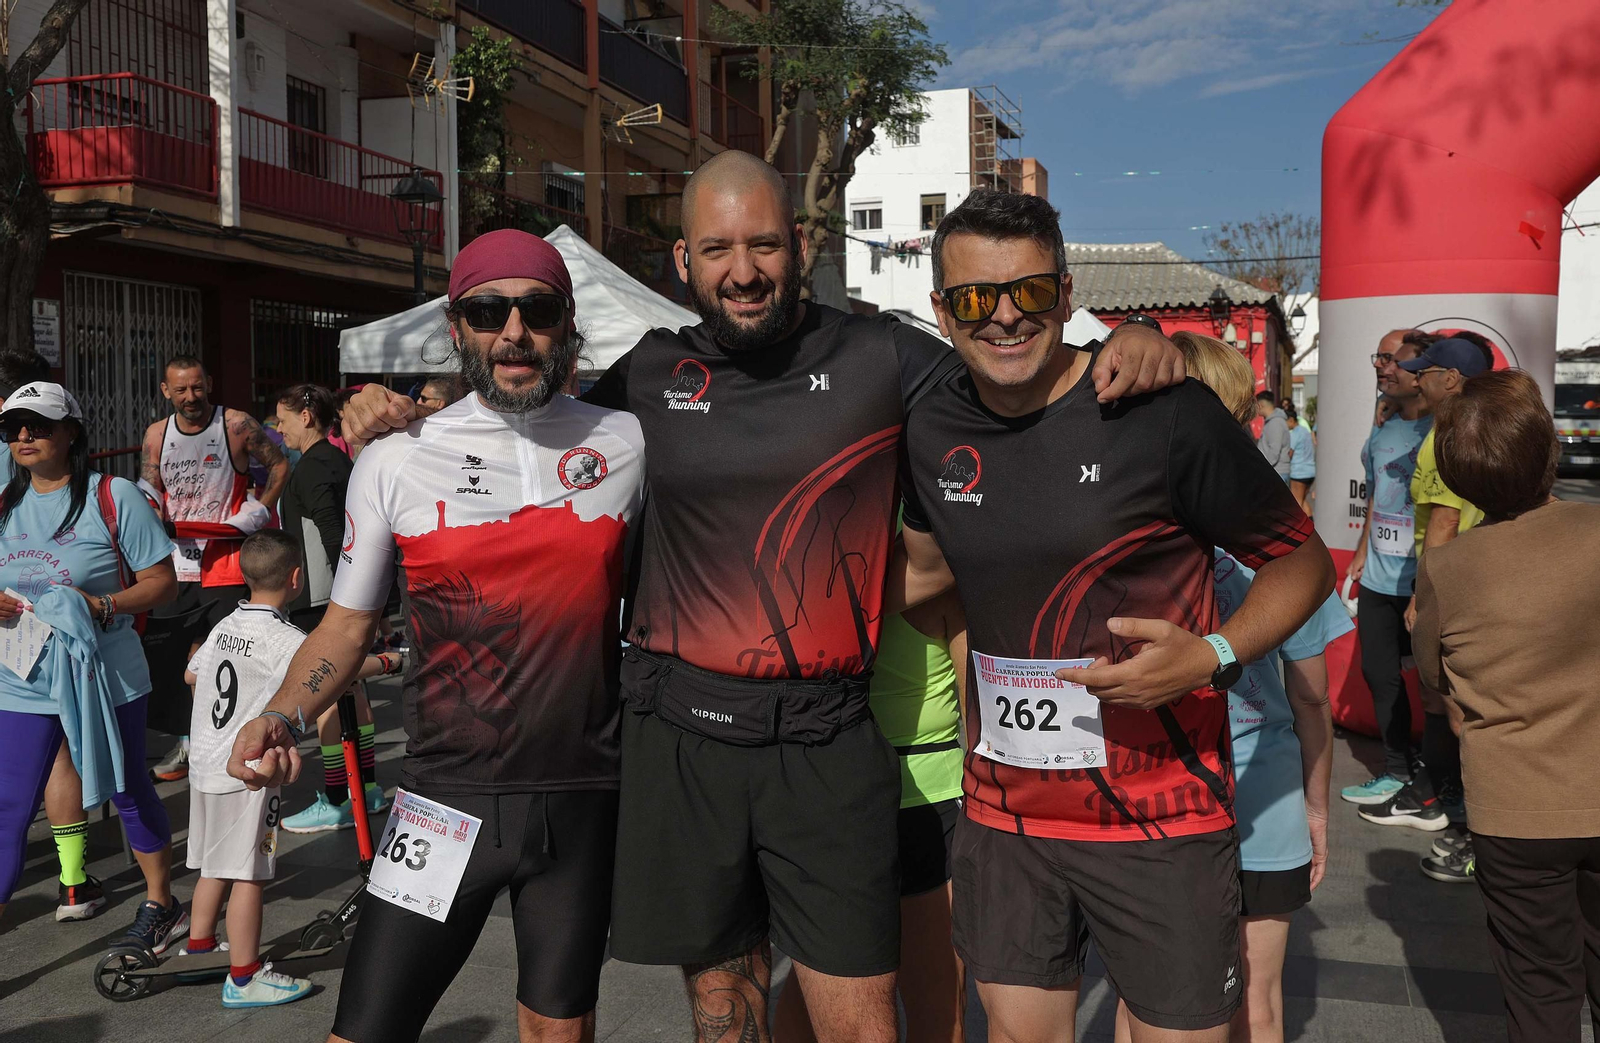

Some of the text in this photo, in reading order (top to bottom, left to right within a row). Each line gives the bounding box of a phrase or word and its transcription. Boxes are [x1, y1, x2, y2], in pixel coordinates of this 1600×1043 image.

[663, 390, 693, 399] Turismo
[667, 399, 711, 413] Running
[163, 458, 197, 473] tengo
[570, 448, 606, 468] RUNNING
[164, 471, 206, 487] sclerosis
[937, 478, 964, 489] Turismo
[455, 487, 492, 495] SPALL
[943, 489, 983, 506] Running
[1349, 479, 1367, 500] De
[182, 501, 220, 521] qué?
[1349, 503, 1368, 518] Ilus
[1377, 526, 1399, 541] 301
[185, 548, 201, 560] 28
[979, 655, 995, 673] VIII
[995, 668, 1024, 677] CARRERA
[981, 671, 1009, 687] PUENTE
[1012, 678, 1065, 689] MAYORGA
[211, 659, 239, 730] 9
[691, 707, 733, 724] KIPRUN
[995, 695, 1061, 731] 262
[265, 795, 280, 828] 9
[404, 811, 448, 836] MAYORGA
[460, 820, 470, 832] 11
[379, 827, 432, 871] 263
[341, 903, 357, 922] A-145
